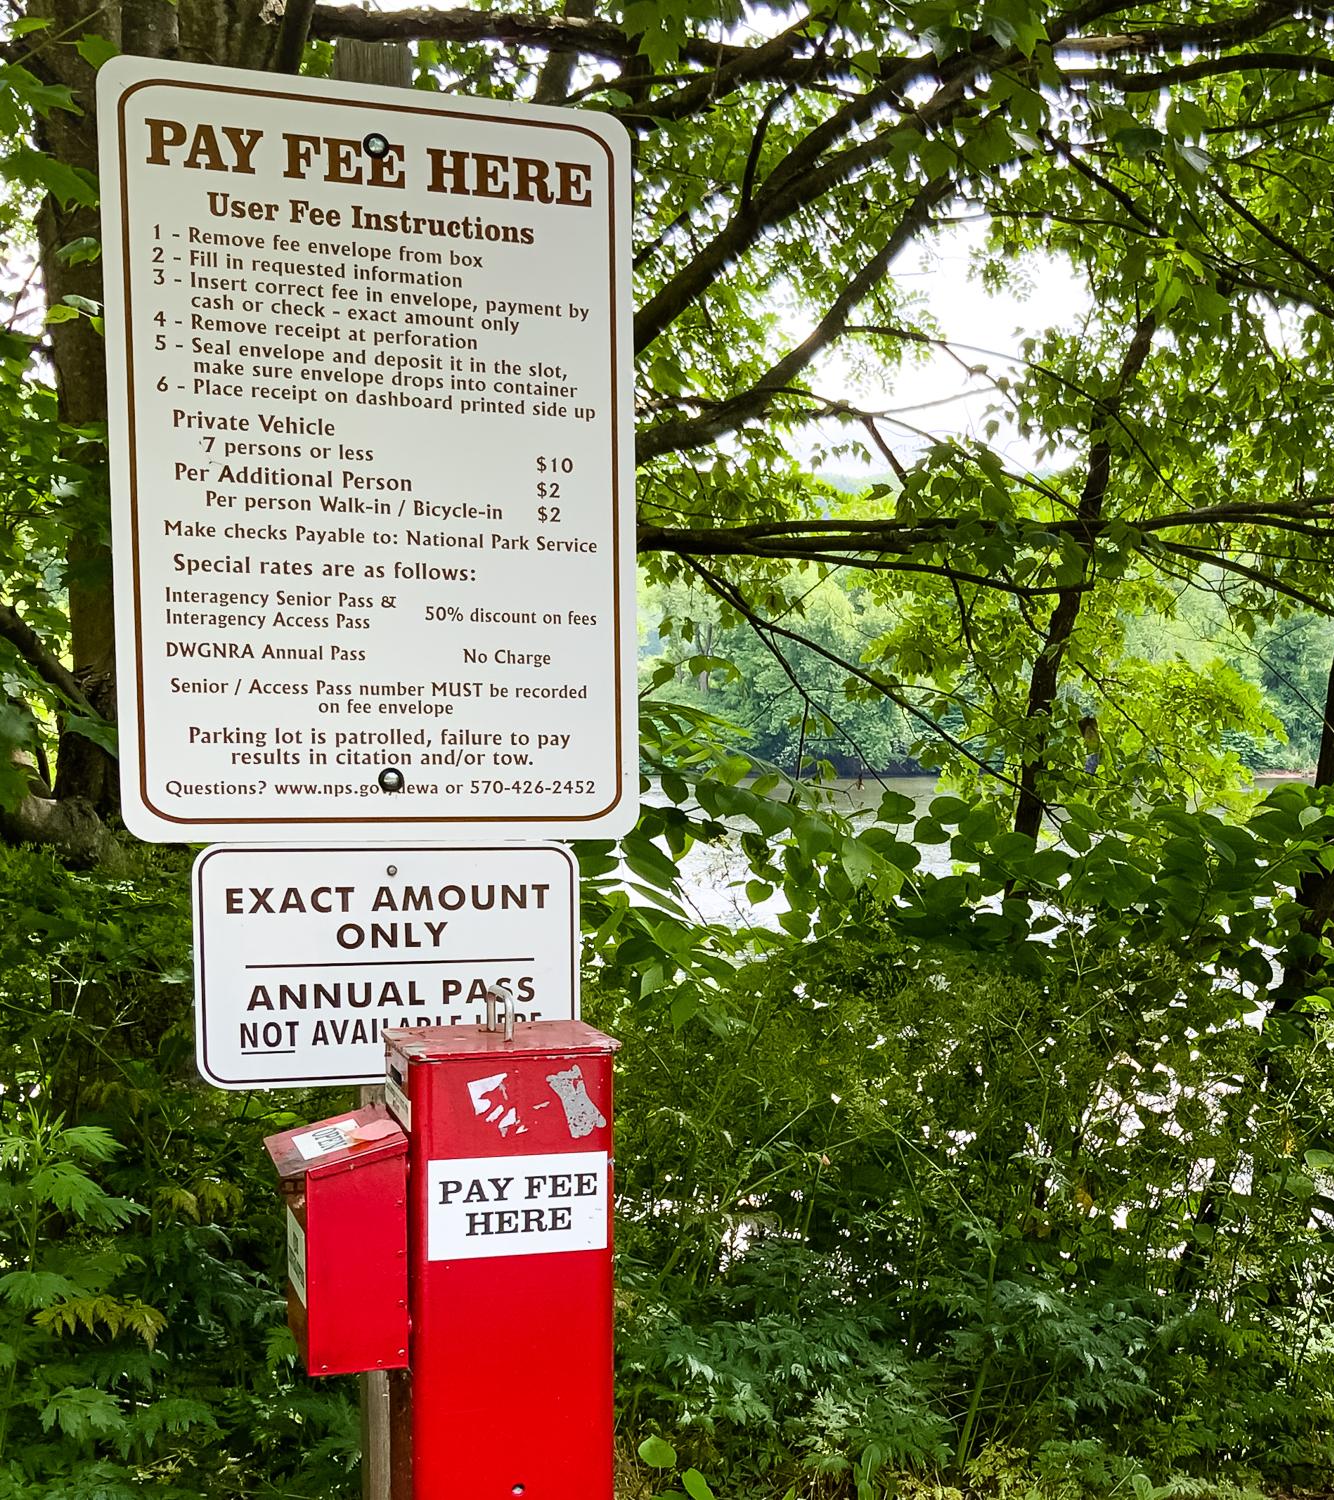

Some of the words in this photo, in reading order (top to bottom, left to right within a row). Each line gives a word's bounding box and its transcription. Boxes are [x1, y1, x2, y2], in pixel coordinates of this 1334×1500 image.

[144, 118, 264, 175] PAY
[282, 133, 405, 189] FEE
[426, 147, 592, 208] HERE
[207, 191, 279, 221] User
[289, 199, 341, 227] Fee
[351, 205, 534, 245] Instructions
[154, 224, 160, 240] 1
[189, 226, 265, 249] Remove
[273, 234, 300, 252] fee
[308, 241, 391, 262] envelope
[399, 245, 442, 264] from
[450, 250, 483, 268] box
[152, 247, 164, 263] 2
[190, 250, 217, 268] Fill
[226, 258, 243, 270] in
[252, 260, 345, 278] requested
[354, 265, 462, 288] information
[153, 269, 165, 285] 3
[190, 272, 247, 292] Insert
[255, 282, 324, 298] correct
[332, 283, 358, 301] fee
[366, 290, 382, 303] in
[391, 292, 477, 313] envelope,
[486, 300, 562, 317] payment
[569, 303, 589, 322] by
[191, 294, 234, 310] cash
[242, 300, 264, 312] or
[271, 299, 325, 317] check
[348, 308, 397, 323] exact
[405, 313, 474, 329] amount
[481, 317, 519, 335] only
[153, 311, 166, 327] 4
[191, 313, 267, 334] Remove
[275, 324, 341, 342] receipt
[348, 329, 366, 342] at
[374, 330, 477, 350] perforation
[155, 334, 166, 351] 5
[192, 337, 230, 355] Seal
[239, 344, 324, 364] envelope
[333, 349, 366, 365] and
[374, 351, 443, 370] deposit
[450, 356, 463, 371] it
[470, 357, 486, 373] in
[494, 360, 521, 375] the
[529, 362, 567, 381] slot,
[194, 359, 244, 376] make
[252, 365, 293, 379] sure
[301, 367, 384, 387] envelope
[392, 371, 443, 391] drops
[451, 378, 486, 392] into
[493, 381, 578, 398] container
[157, 376, 168, 392] 6
[194, 378, 243, 397] Place
[252, 386, 317, 404] receipt
[325, 391, 348, 403] on
[356, 389, 452, 410] dashboard
[461, 400, 525, 415] printed
[533, 402, 567, 417] side
[575, 408, 595, 422] up
[173, 409, 249, 431] Private
[258, 414, 335, 436] Vehicle
[203, 436, 215, 453] 7
[225, 442, 301, 457] persons
[310, 447, 331, 459] or
[339, 444, 373, 461] less
[175, 462, 210, 481] Per
[218, 465, 332, 488] Additional
[342, 471, 412, 492] Person
[536, 456, 573, 473] $10
[537, 481, 560, 499] $2
[206, 490, 237, 507] Per
[245, 497, 311, 511] person
[319, 496, 391, 514] Walk-in
[398, 500, 406, 517] /
[414, 500, 502, 520] Bicycle-in
[538, 506, 561, 523] $2
[164, 520, 216, 537] Make
[224, 523, 287, 540] checks
[296, 525, 365, 545] Payable
[373, 531, 397, 544] to:
[406, 530, 483, 548] National
[492, 534, 529, 550] Park
[537, 536, 597, 553] Service
[174, 553, 250, 575] Special
[260, 560, 313, 576] rates
[322, 564, 354, 577] are
[364, 565, 385, 578] as
[394, 562, 475, 581] follows:
[166, 587, 269, 608] Interagency
[276, 590, 332, 607] Senior
[339, 592, 373, 608] Pass
[381, 596, 396, 608] &
[166, 609, 266, 629] Interagency
[273, 612, 329, 628] Access
[336, 613, 370, 629] Pass
[425, 606, 463, 622] 50%
[470, 608, 537, 624] discount
[543, 614, 561, 624] on
[568, 610, 596, 625] fees
[166, 642, 254, 658] DWGNRA
[261, 644, 323, 660] Annual
[331, 646, 365, 661] Pass
[463, 648, 487, 663] No
[495, 649, 551, 668] Charge
[171, 678, 229, 693] Senior
[234, 679, 242, 695] /
[248, 679, 308, 694] Access
[317, 680, 351, 695] Pass
[360, 682, 425, 696] number
[431, 682, 483, 697] MUST
[490, 683, 508, 698] be
[516, 685, 587, 699] recorded
[319, 703, 339, 713] on
[347, 699, 371, 714] fee
[379, 700, 453, 717] envelope
[189, 727, 267, 747] Parking
[276, 728, 302, 744] lot
[311, 728, 326, 744] is
[336, 729, 431, 748] patrolled,
[441, 729, 502, 745] failure
[511, 732, 529, 745] to
[538, 734, 570, 749] pay
[232, 748, 300, 765] results
[310, 748, 327, 765] in
[336, 749, 411, 765] citation
[421, 749, 485, 767] and/or
[493, 752, 533, 765] tow.
[166, 780, 266, 798] Questions?
[275, 777, 438, 797] www.nps.godewa
[446, 784, 463, 794] or
[470, 780, 595, 794] 570-426-2452
[226, 887, 355, 914] EXACT
[371, 884, 549, 911] AMOUNT
[336, 922, 448, 949] ONLY
[247, 981, 425, 1011] ANNUAL
[442, 977, 535, 1004] PASS
[240, 1021, 299, 1048] NOT
[439, 1177, 514, 1205] PAY
[524, 1173, 597, 1199] FEE
[466, 1207, 571, 1236] HERE
